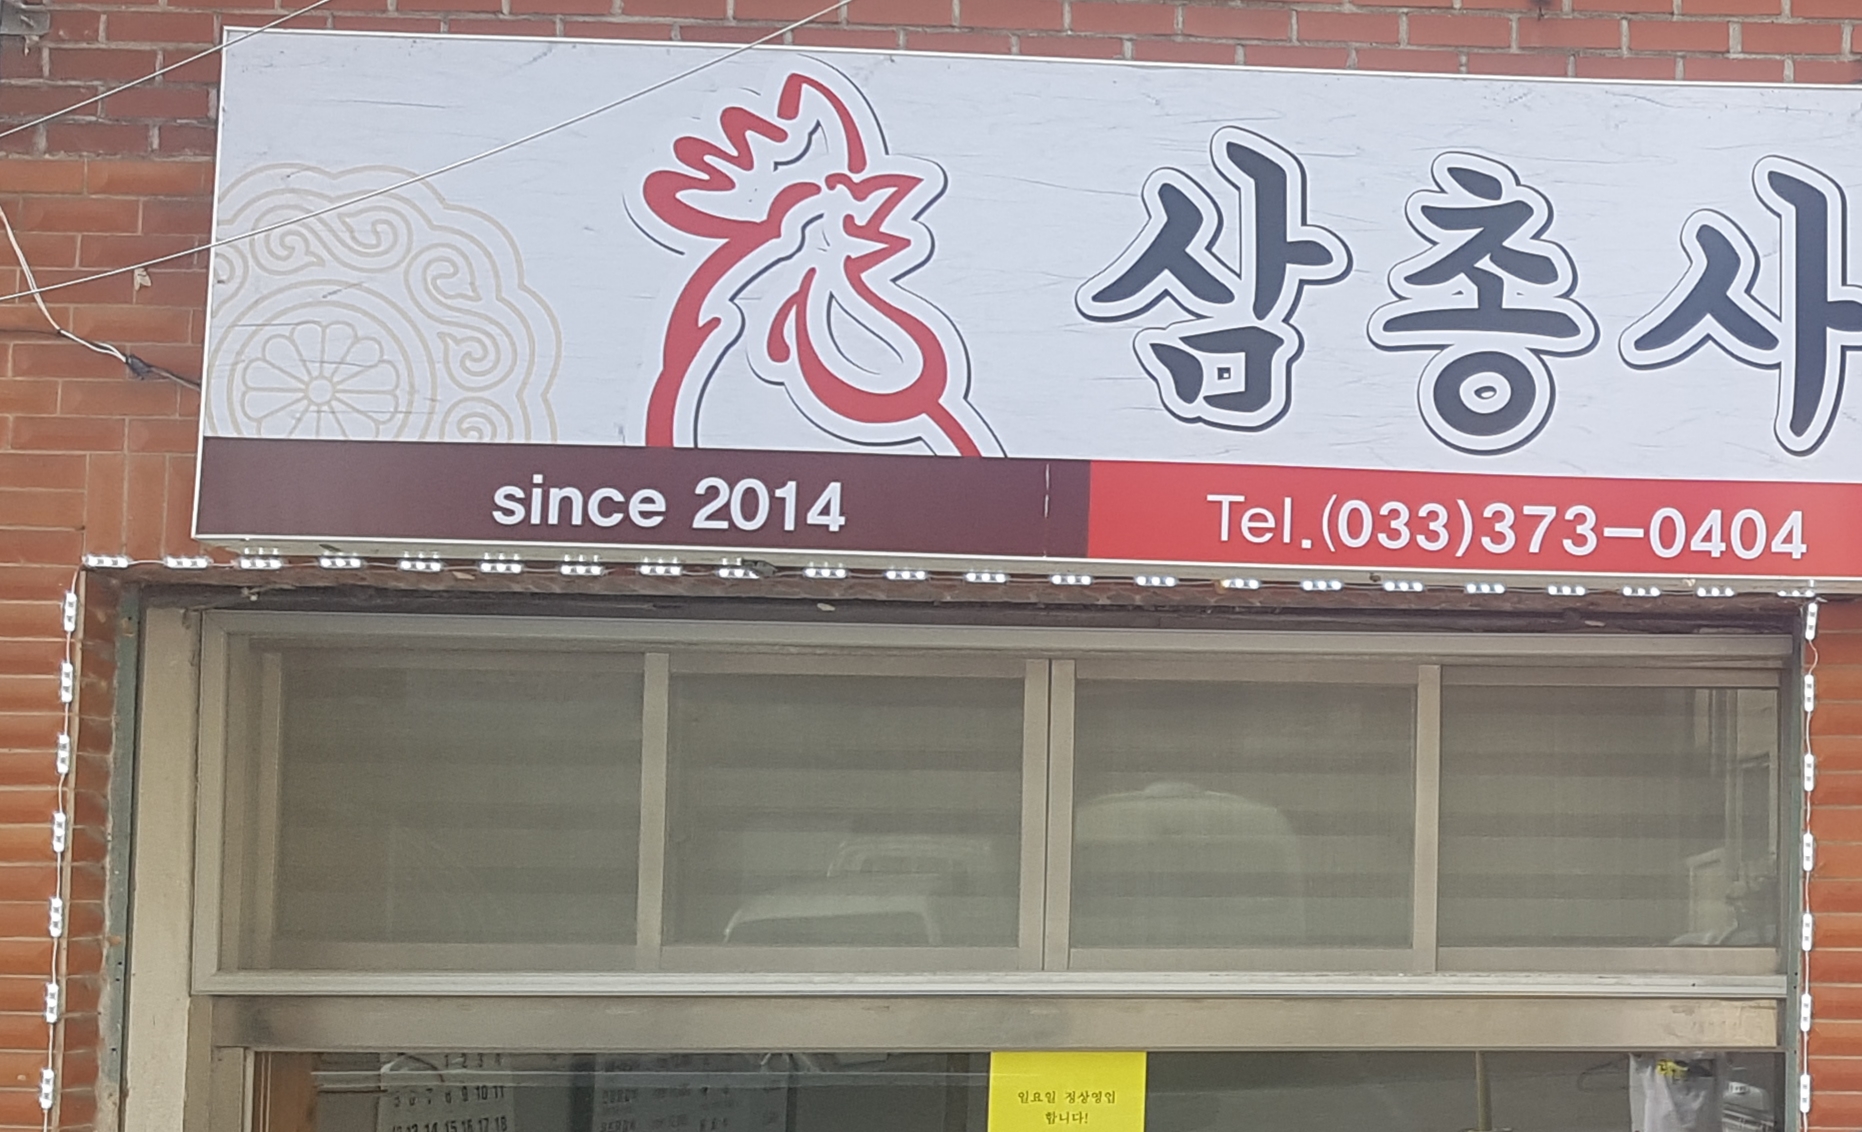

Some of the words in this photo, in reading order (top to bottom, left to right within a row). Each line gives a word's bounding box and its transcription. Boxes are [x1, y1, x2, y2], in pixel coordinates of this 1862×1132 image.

[491, 477, 666, 530] since
[692, 476, 847, 534] 2014
[1017, 1091, 1056, 1104] 일요일
[1064, 1090, 1116, 1104] 정상영업
[1045, 1111, 1089, 1125] 합니다!
